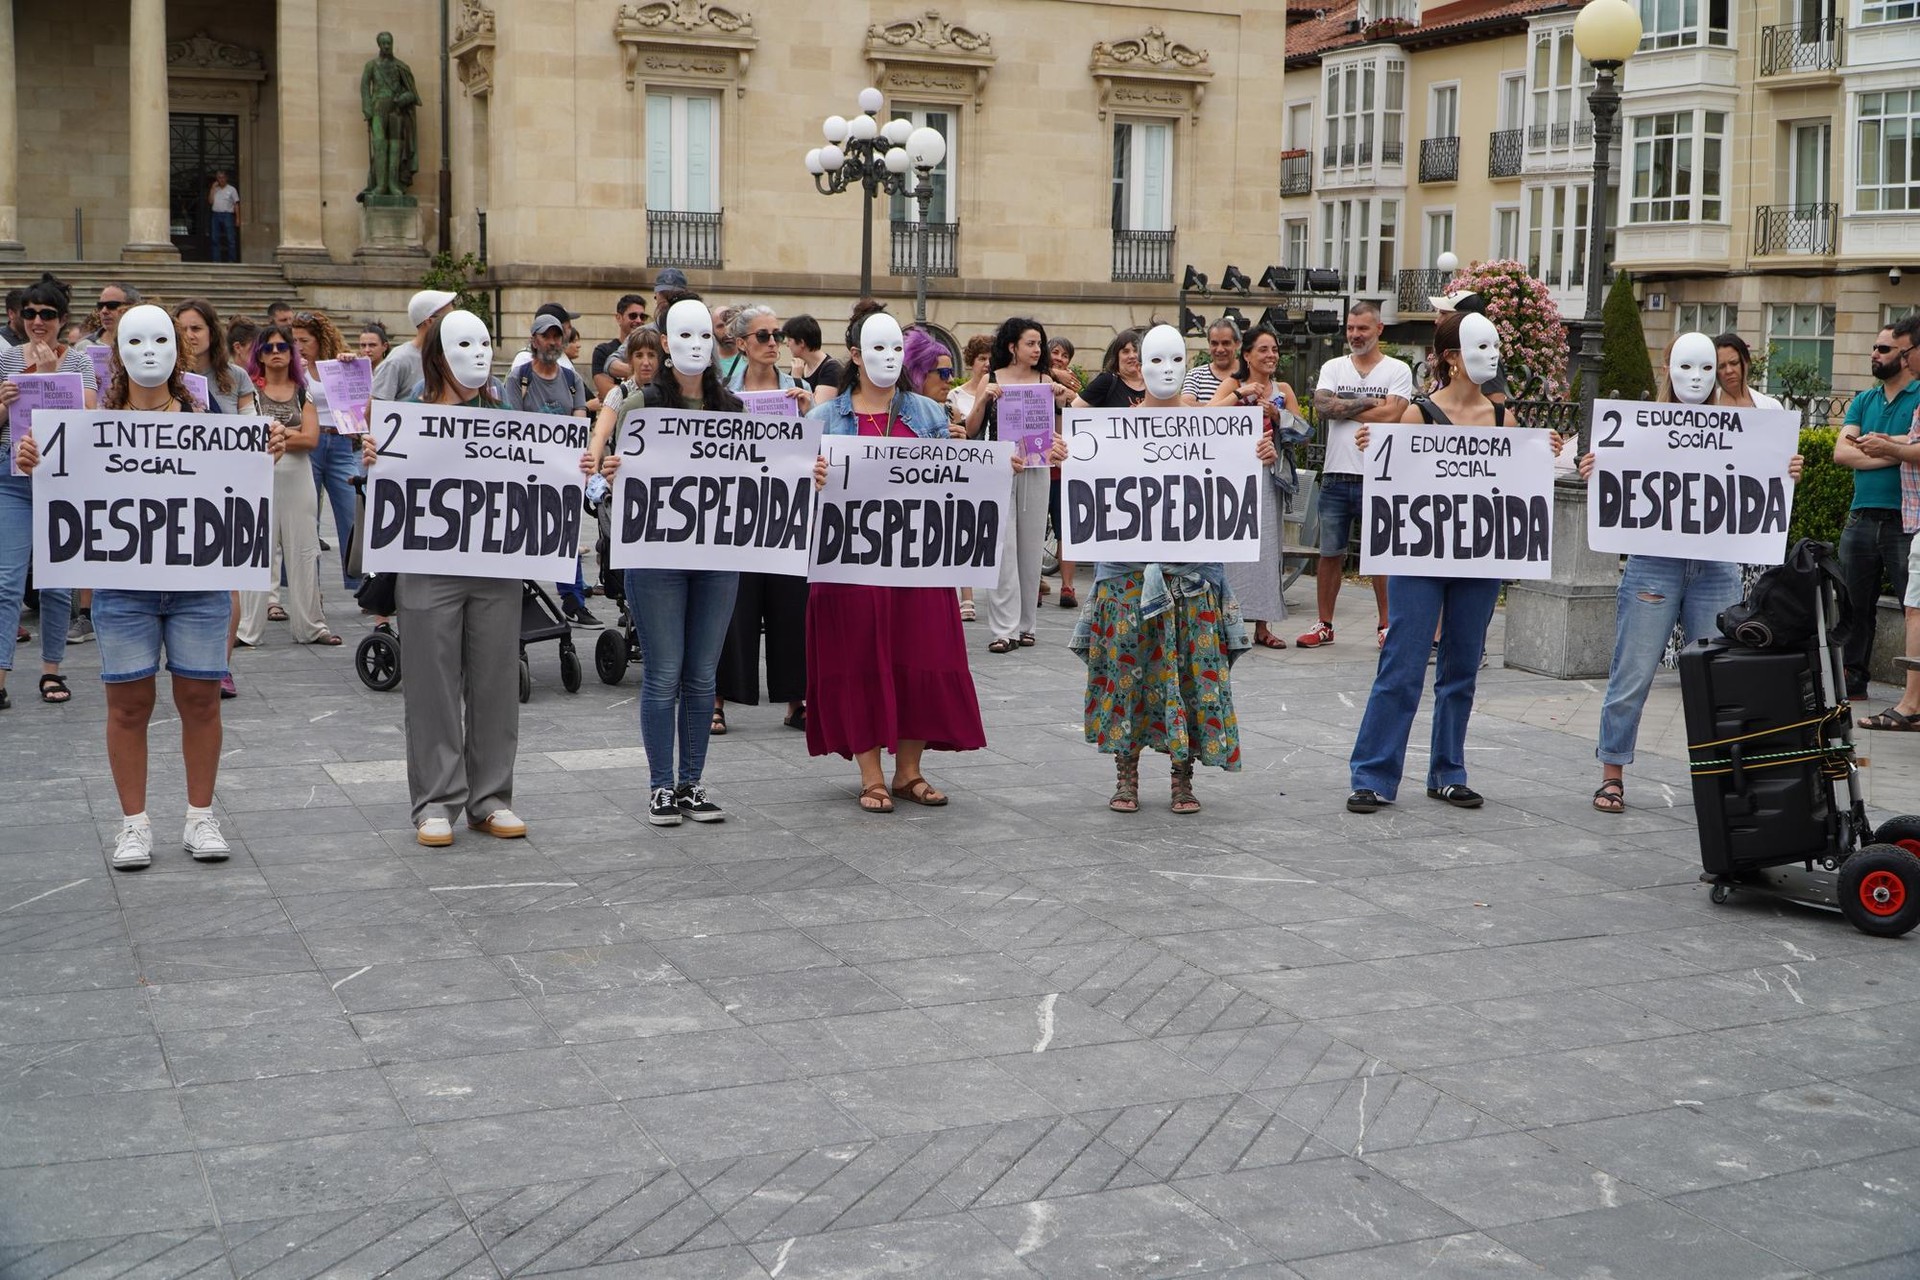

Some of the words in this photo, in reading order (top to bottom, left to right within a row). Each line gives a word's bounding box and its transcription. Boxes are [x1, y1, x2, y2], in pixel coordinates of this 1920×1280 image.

[44, 381, 56, 391] NO
[42, 422, 69, 477] 1
[377, 412, 408, 460] 2
[418, 415, 589, 449] INTEGRADORA
[623, 418, 646, 456] 3
[657, 417, 804, 441] INTEGRADORA
[1072, 418, 1099, 462] 5
[1105, 415, 1253, 440] INTEGRADORA
[1598, 410, 1625, 448] 2
[1636, 410, 1744, 433] EDUCADORA
[829, 446, 850, 490] 4
[861, 444, 995, 465] INTEGRADORA
[1373, 434, 1394, 482] 1
[1410, 435, 1512, 457] EDUCADORA
[1435, 459, 1497, 478] SOCIAL
